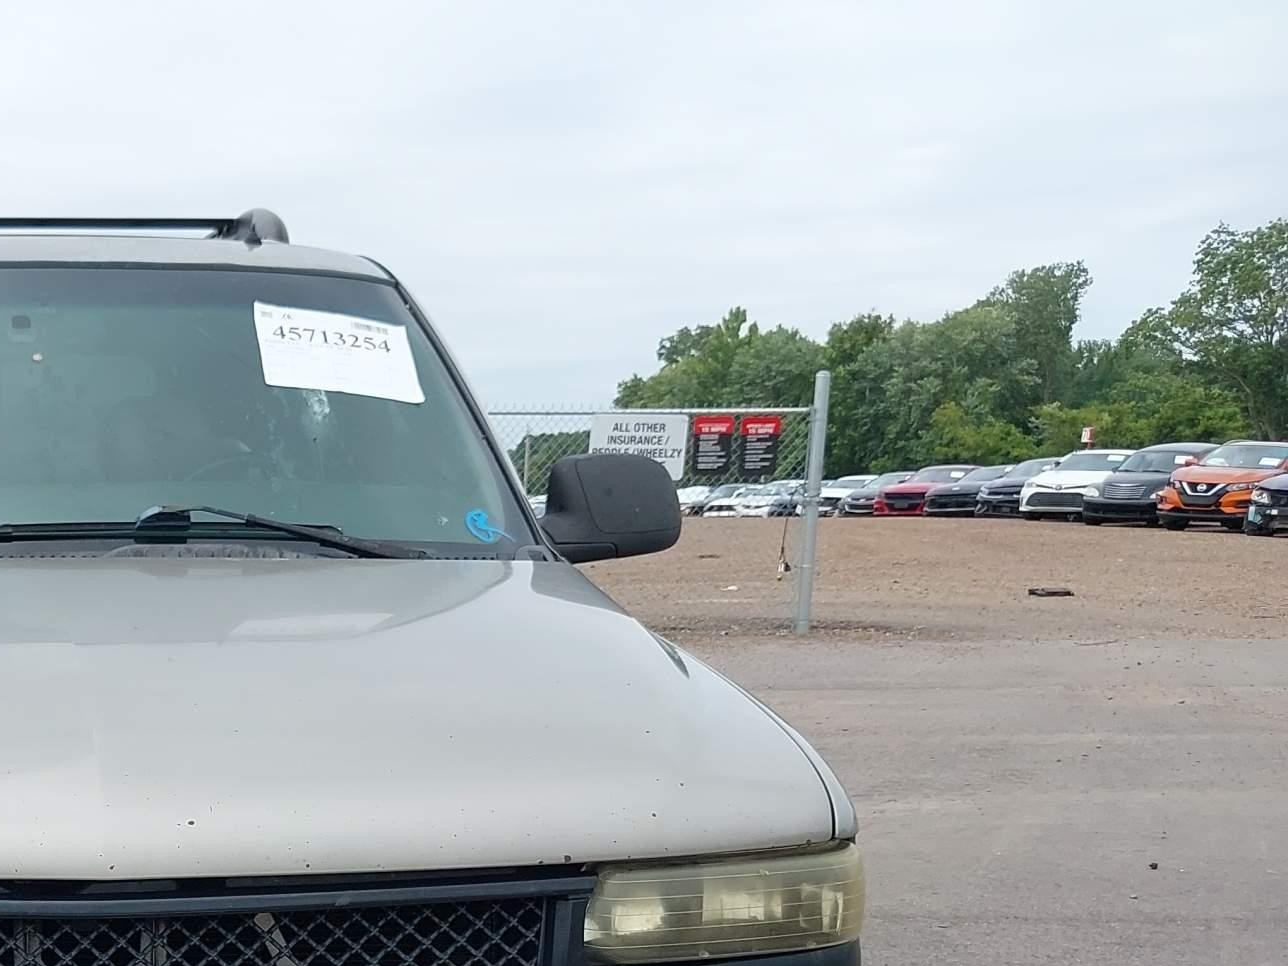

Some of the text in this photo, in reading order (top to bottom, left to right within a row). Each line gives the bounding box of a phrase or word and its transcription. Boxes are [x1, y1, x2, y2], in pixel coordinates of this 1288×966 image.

[272, 325, 391, 353] 45713254
[612, 422, 666, 433] ALL OTHER
[607, 435, 663, 446] INSURANCE
